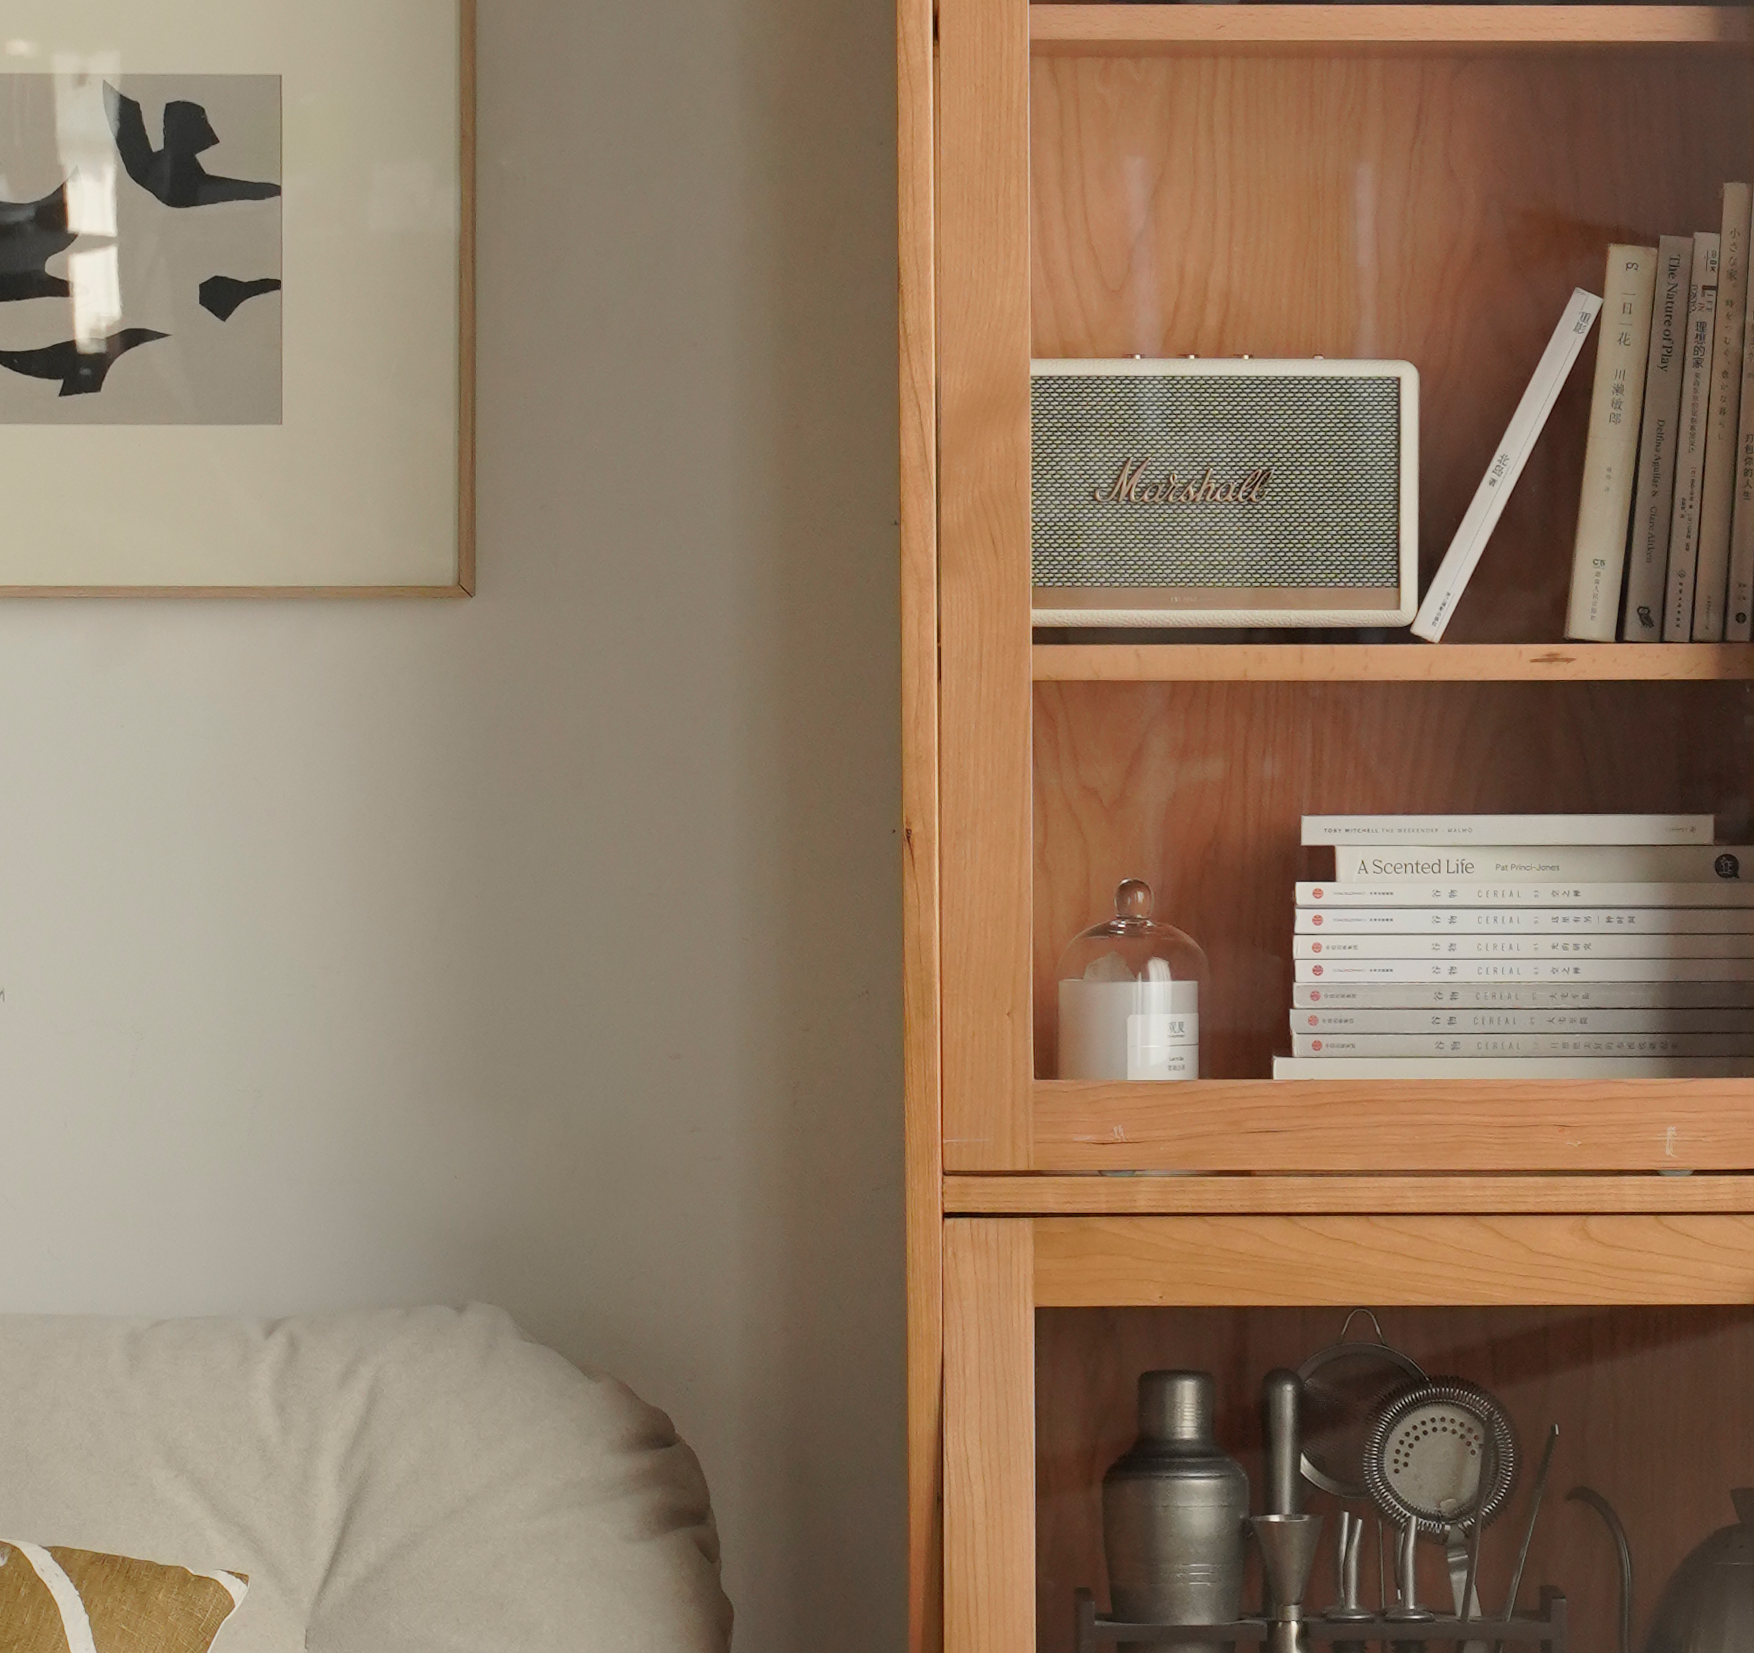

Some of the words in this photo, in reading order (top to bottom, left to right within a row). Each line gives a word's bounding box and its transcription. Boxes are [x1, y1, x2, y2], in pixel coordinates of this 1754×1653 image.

[1668, 253, 1681, 278] The
[1665, 281, 1679, 325] Nature
[1617, 291, 1637, 347] 一日一花
[1657, 345, 1674, 372] Play
[1094, 456, 1276, 505] Marshall
[1323, 826, 1341, 834] TOBY
[1344, 826, 1379, 834] MITCHELL
[1381, 826, 1395, 834] THE
[1357, 858, 1369, 875] A
[1372, 858, 1441, 876] Scented
[1445, 858, 1475, 875] Life
[1495, 862, 1510, 872] Pat
[1510, 862, 1560, 873] Princi-Jones
[1477, 889, 1522, 899] CEREAL
[1477, 915, 1522, 925] CEREAL
[1477, 942, 1522, 952] CEREAL
[1477, 966, 1522, 976] CEREAL
[1475, 991, 1520, 1001] CEREAL
[1473, 1016, 1518, 1026] CEREAL
[1477, 1041, 1522, 1051] CEREAL
